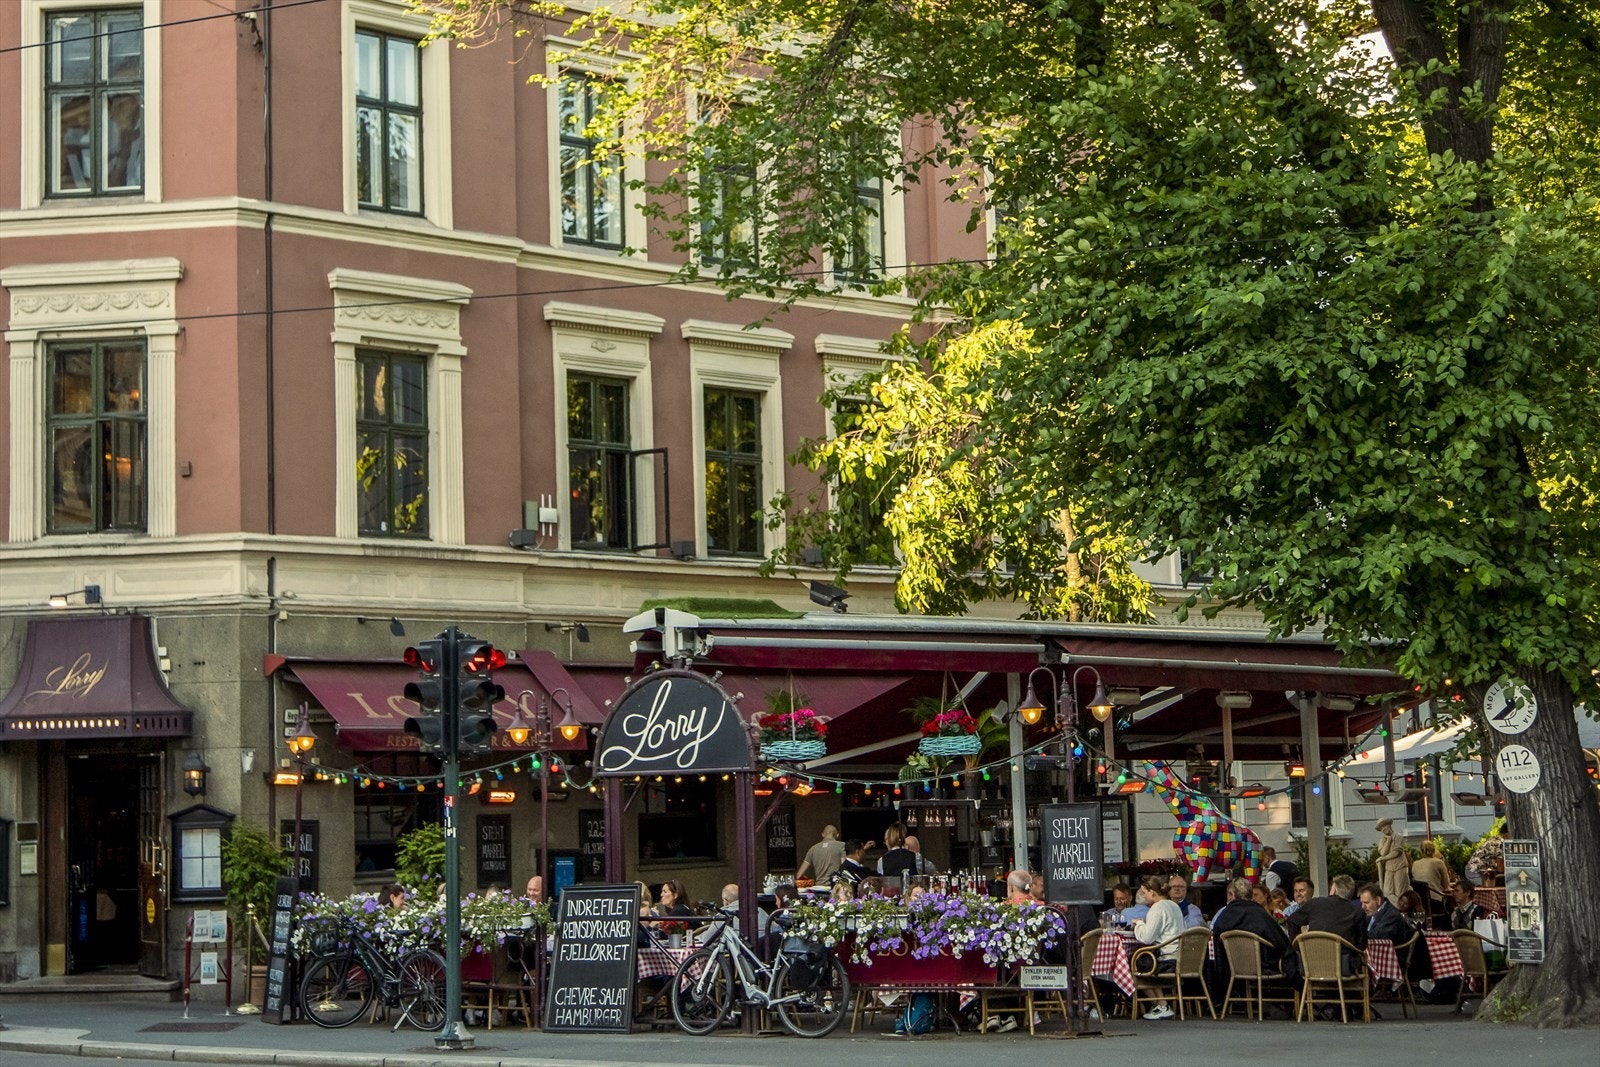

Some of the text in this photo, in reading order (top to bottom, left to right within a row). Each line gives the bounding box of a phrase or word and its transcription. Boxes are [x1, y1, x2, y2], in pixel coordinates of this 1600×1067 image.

[24, 652, 109, 704] Lorry
[600, 679, 726, 771] Lorry
[501, 735, 511, 747] &
[1500, 749, 1532, 768] H12
[1514, 773, 1538, 781] GALLERY
[1052, 817, 1090, 839] STEKT
[1051, 842, 1094, 864] MAKRELL
[1508, 843, 1533, 853] EMBLA
[1052, 866, 1095, 881] AGURKSALAT
[567, 899, 633, 917] INDREFILET
[562, 920, 631, 939] REINSDYRKAKER
[560, 943, 630, 961] FJELLØRRET
[554, 987, 628, 1006] CHEVRE SALAT
[555, 1007, 623, 1026] HAMBURGER
